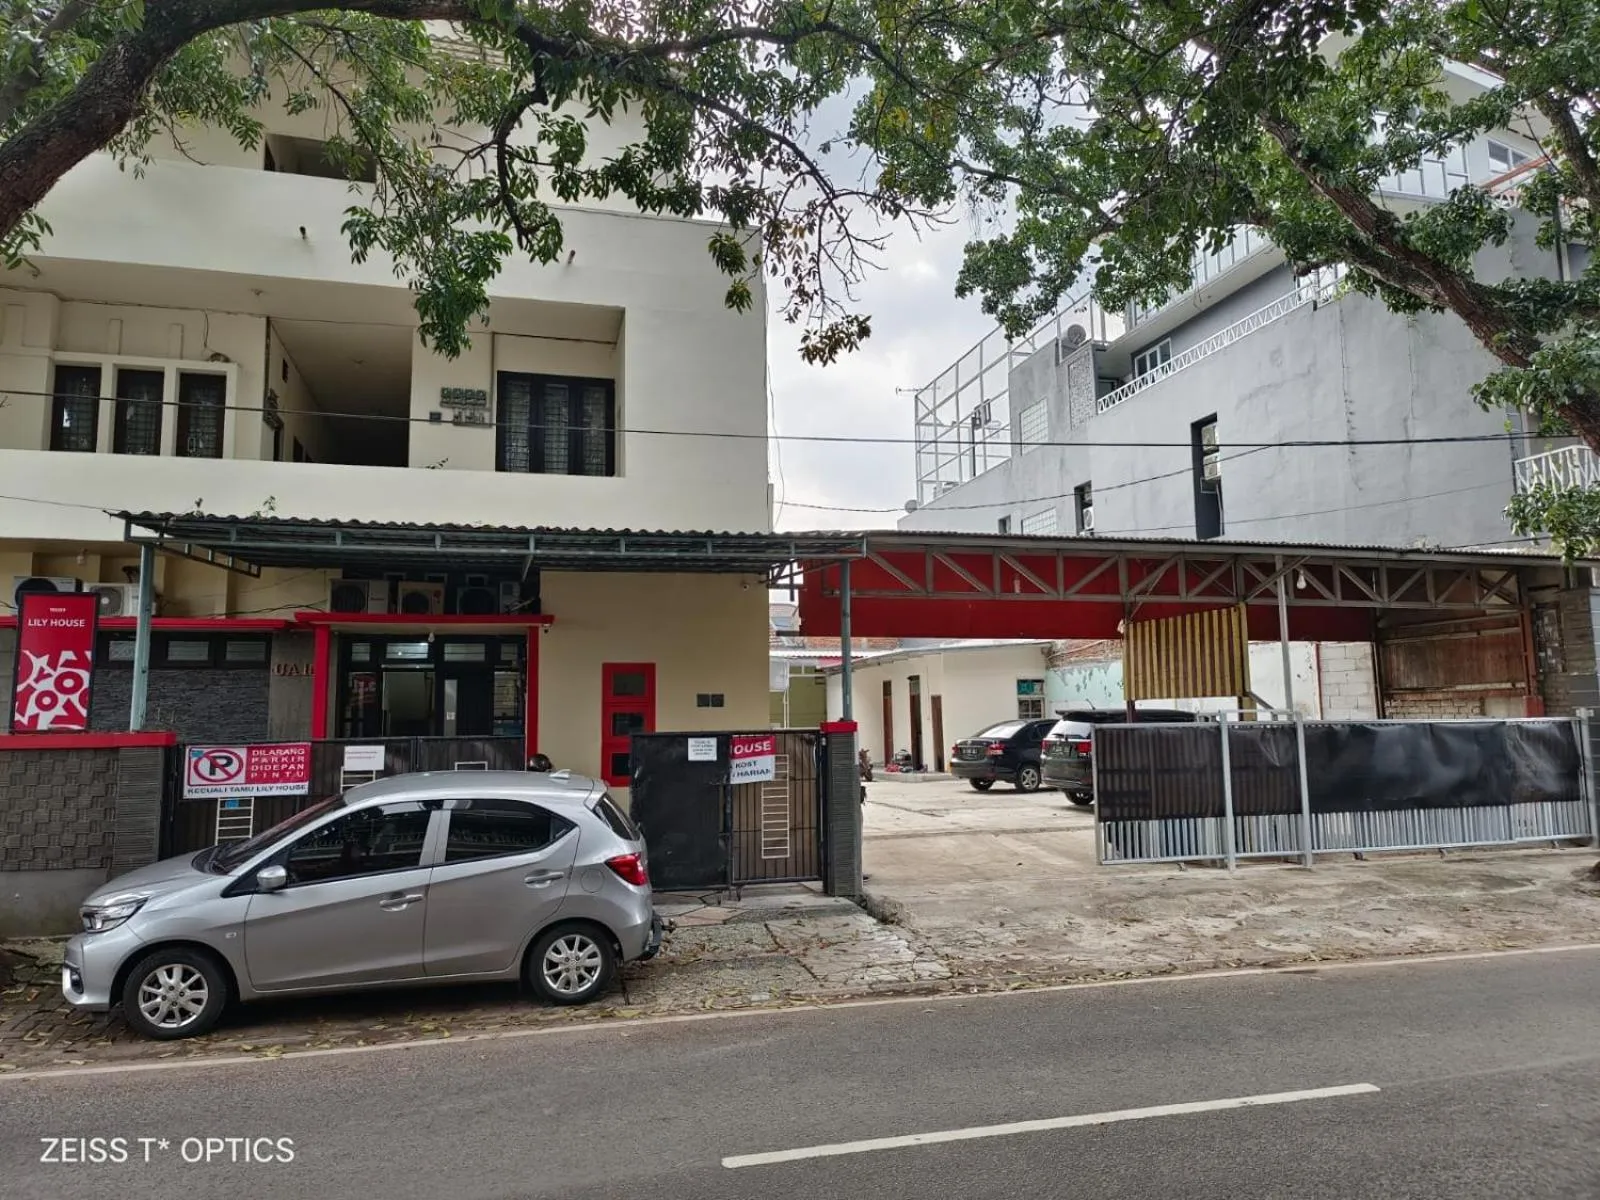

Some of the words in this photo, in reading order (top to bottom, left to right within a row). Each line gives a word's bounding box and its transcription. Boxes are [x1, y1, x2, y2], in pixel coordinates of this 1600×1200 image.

[28, 618, 48, 626] LILY
[50, 618, 85, 627] HOUSE
[252, 748, 305, 756] DILARANG
[731, 741, 771, 755] OUSE
[251, 763, 304, 771] DIDEPAN
[735, 760, 757, 769] KOST
